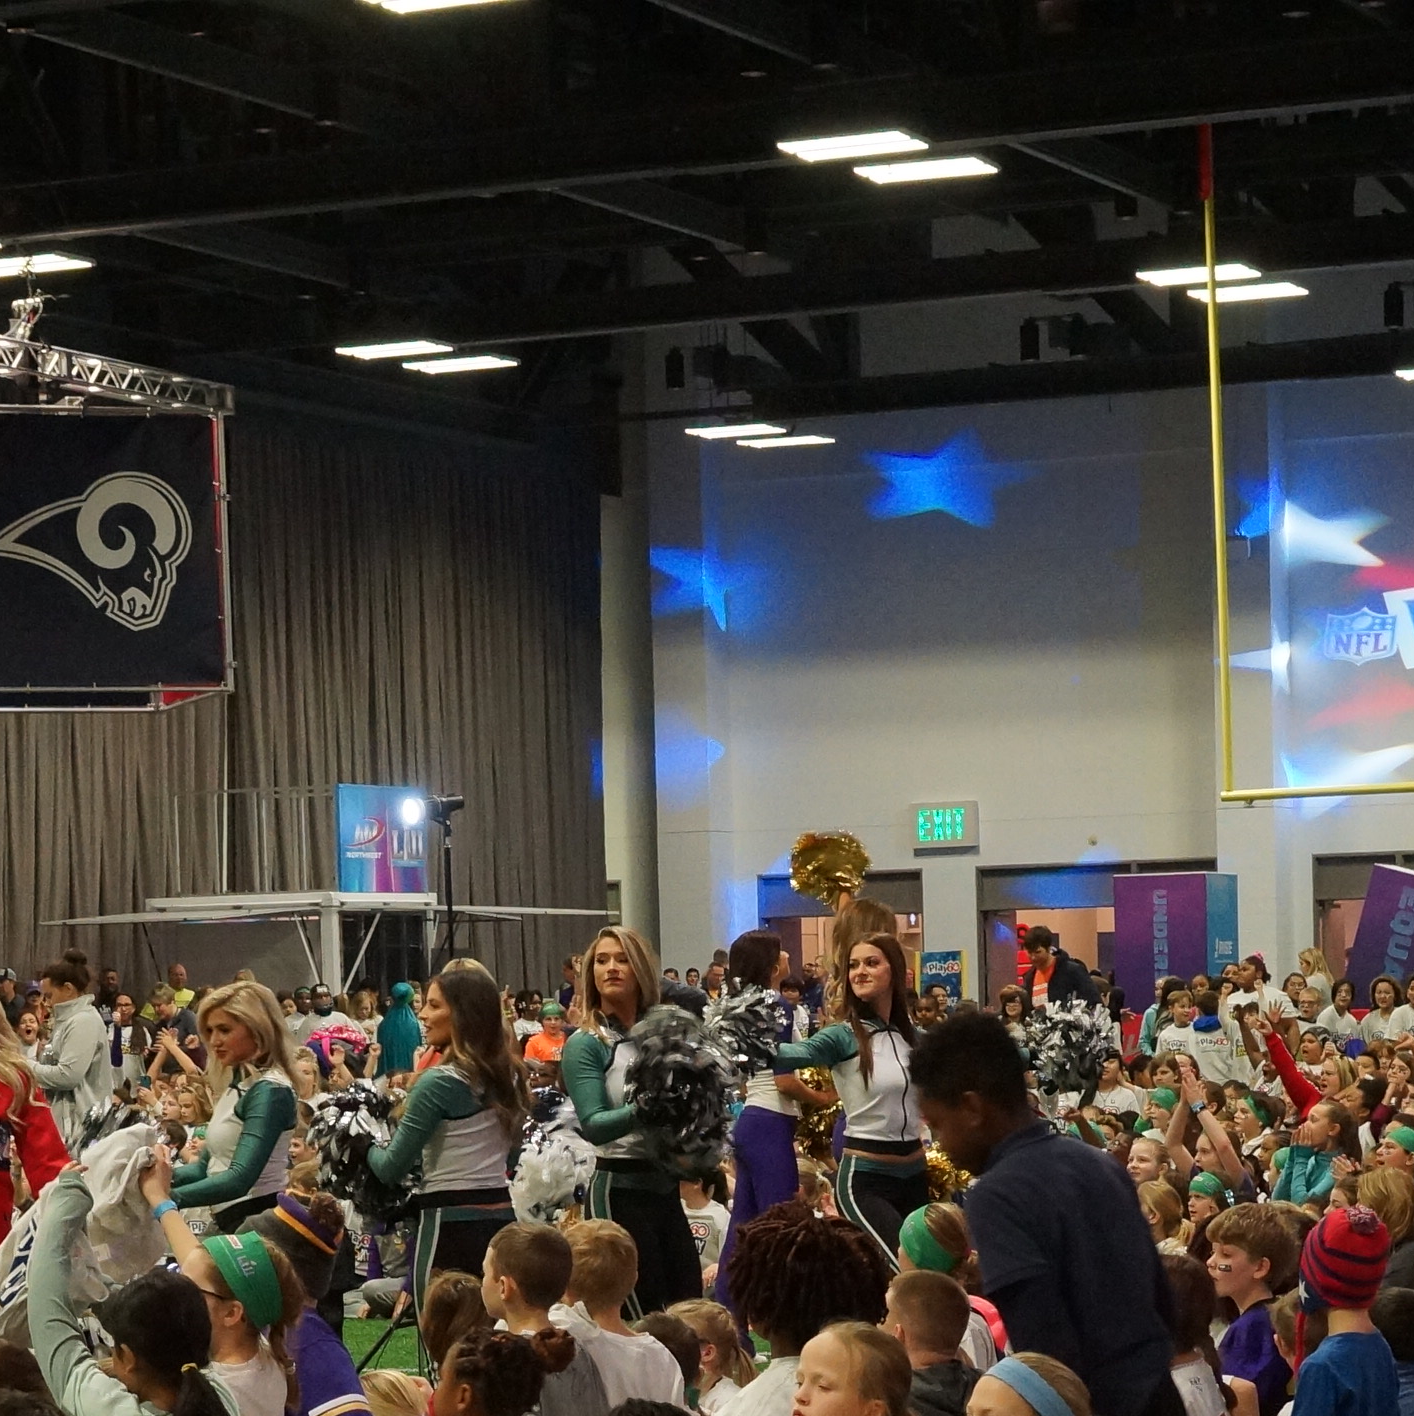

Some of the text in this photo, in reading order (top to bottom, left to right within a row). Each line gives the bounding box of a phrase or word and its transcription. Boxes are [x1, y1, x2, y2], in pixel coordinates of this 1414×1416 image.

[1334, 631, 1389, 656] NFL
[917, 807, 965, 843] EXIT
[1152, 889, 1169, 981] UNDER
